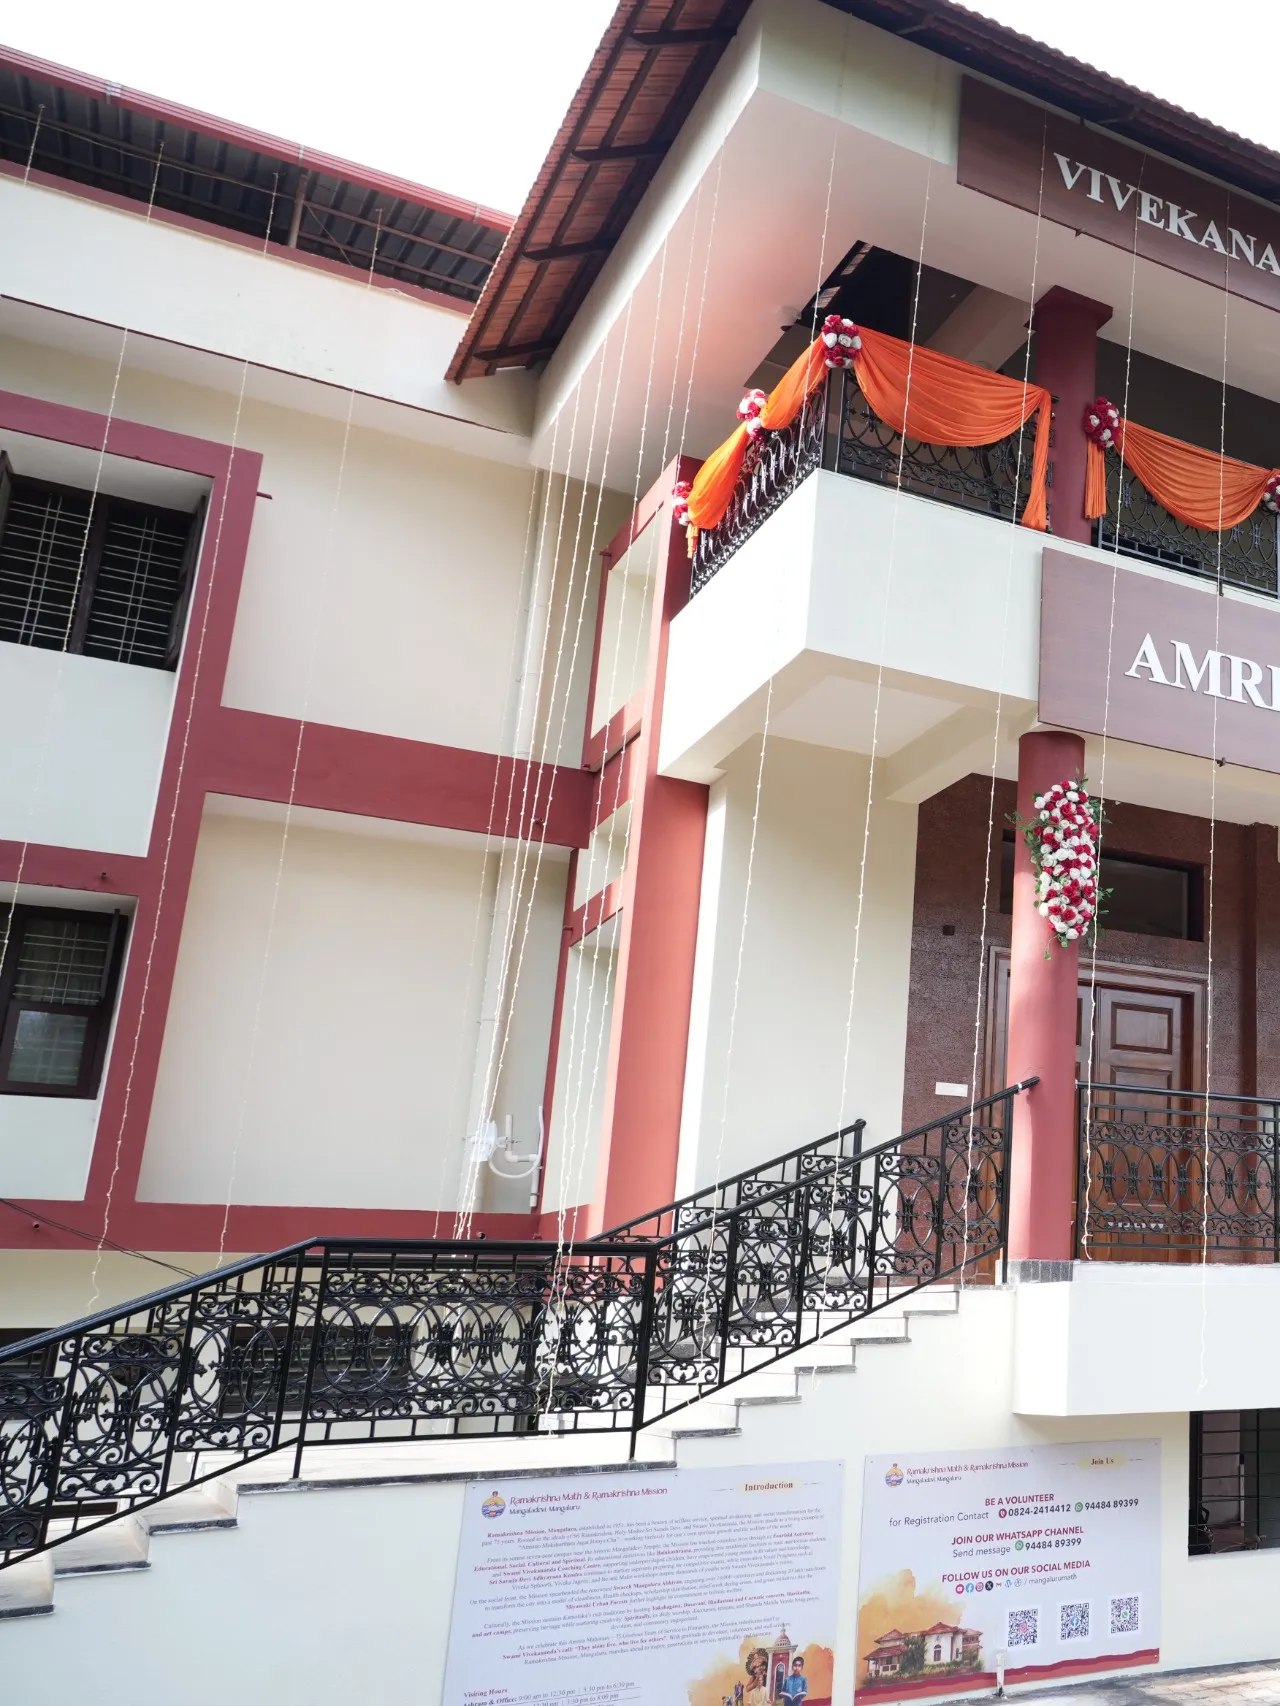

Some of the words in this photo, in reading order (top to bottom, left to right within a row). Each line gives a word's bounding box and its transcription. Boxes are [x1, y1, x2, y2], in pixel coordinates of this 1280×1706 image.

[1091, 1458, 1104, 1466] Join
[745, 1481, 793, 1491] Introduction
[510, 1494, 561, 1506] Ramakrishna
[562, 1492, 582, 1501] Math
[583, 1492, 590, 1500] &
[592, 1489, 640, 1502] Ramakrishna
[641, 1487, 668, 1496] Mission
[985, 1498, 996, 1507] BE
[997, 1497, 1004, 1506] A
[1005, 1493, 1055, 1505] VOLUNTEER
[889, 1517, 902, 1527] for
[904, 1513, 955, 1528] Registration
[957, 1511, 989, 1522] Contact
[1008, 1503, 1071, 1518] 0824-2414412
[1084, 1500, 1112, 1511] 94484
[1113, 1498, 1139, 1509] 89399
[951, 1535, 973, 1546] JOIN
[975, 1533, 994, 1544] OUR
[995, 1529, 1043, 1542] WHATSAPP
[1044, 1525, 1084, 1538] CHANNEL
[952, 1548, 974, 1558] Send
[976, 1545, 1011, 1556] message
[1025, 1540, 1053, 1551] 94484
[1054, 1537, 1082, 1548] 89399
[942, 1571, 980, 1583] FOLLOW
[981, 1569, 993, 1579] US
[995, 1568, 1008, 1577] ON
[1010, 1566, 1029, 1576] OUR
[1031, 1563, 1062, 1573] SOCIAL
[1063, 1559, 1091, 1570] MEDIA
[1028, 1572, 1078, 1585] mangalurumath
